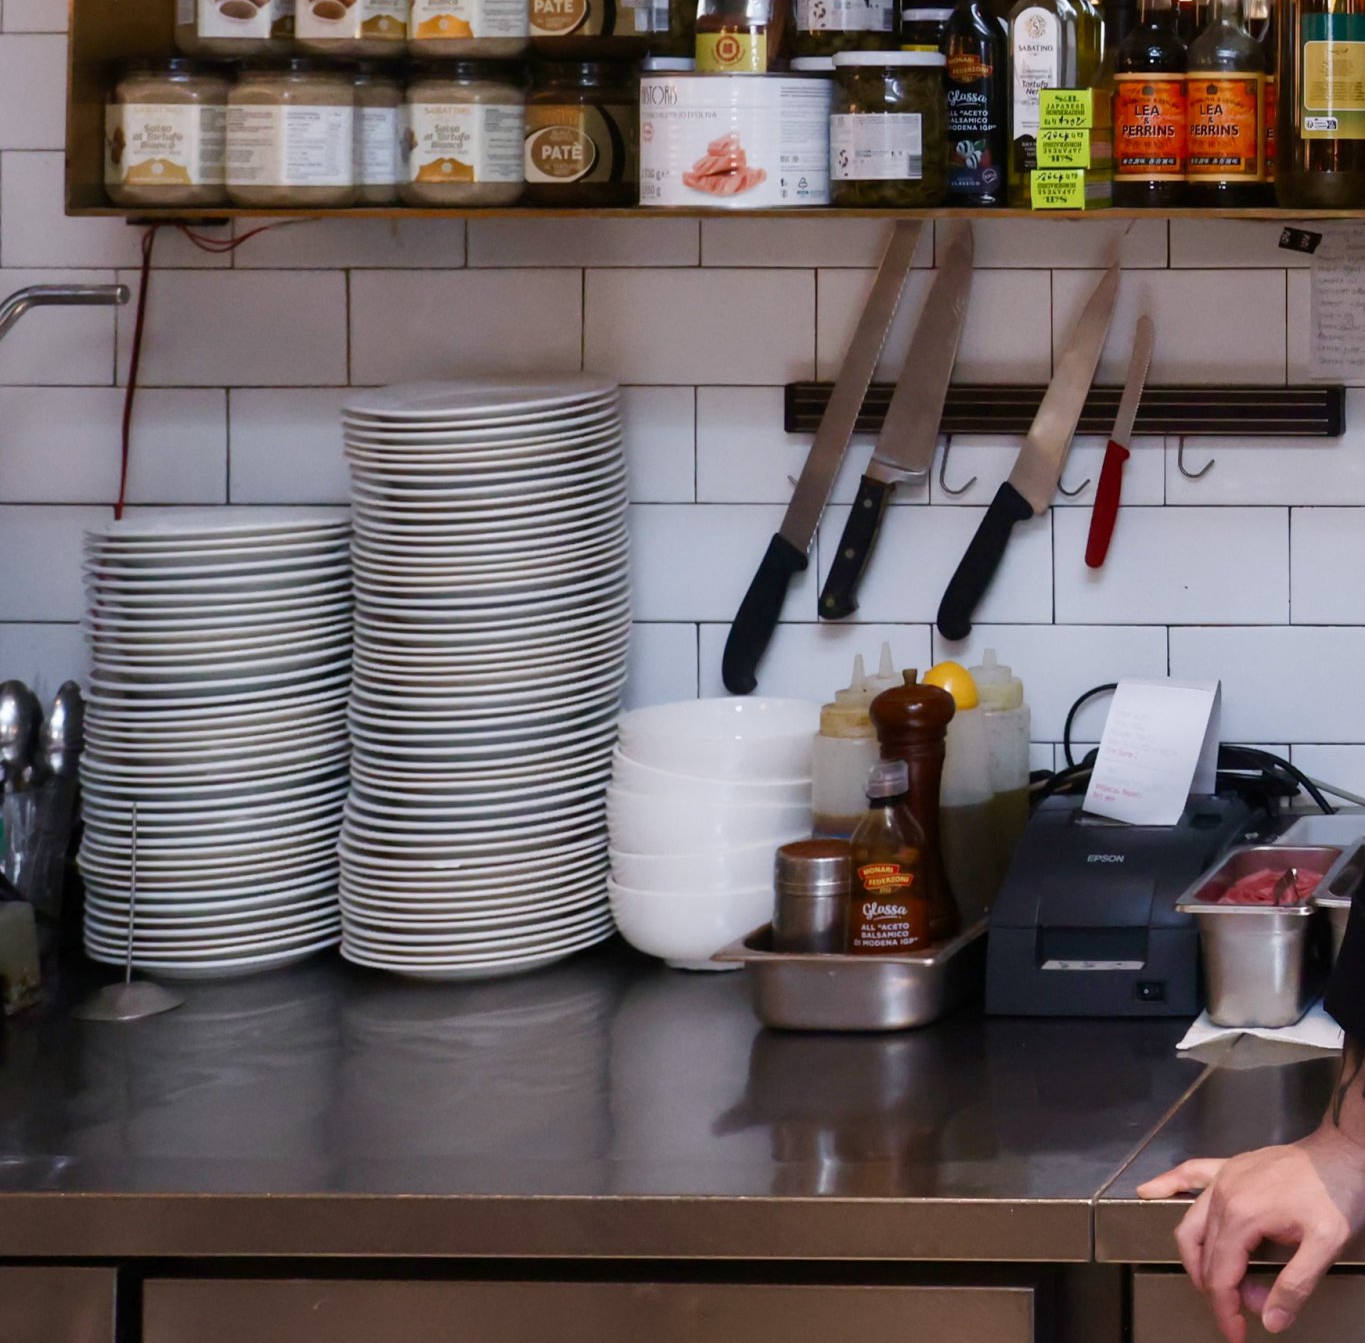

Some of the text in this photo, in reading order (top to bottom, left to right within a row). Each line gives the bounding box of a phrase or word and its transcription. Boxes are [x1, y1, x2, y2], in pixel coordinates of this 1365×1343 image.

[1022, 80, 1048, 90] Tartufo
[1135, 104, 1160, 117] LEA
[1200, 105, 1223, 116] LEA
[1122, 125, 1175, 137] PERRINS
[1190, 125, 1239, 137] PERRINS
[542, 142, 583, 160] PATÈ
[863, 867, 893, 875] MONARI
[868, 876, 909, 885] FEDERZONI
[863, 902, 908, 920] Glassa
